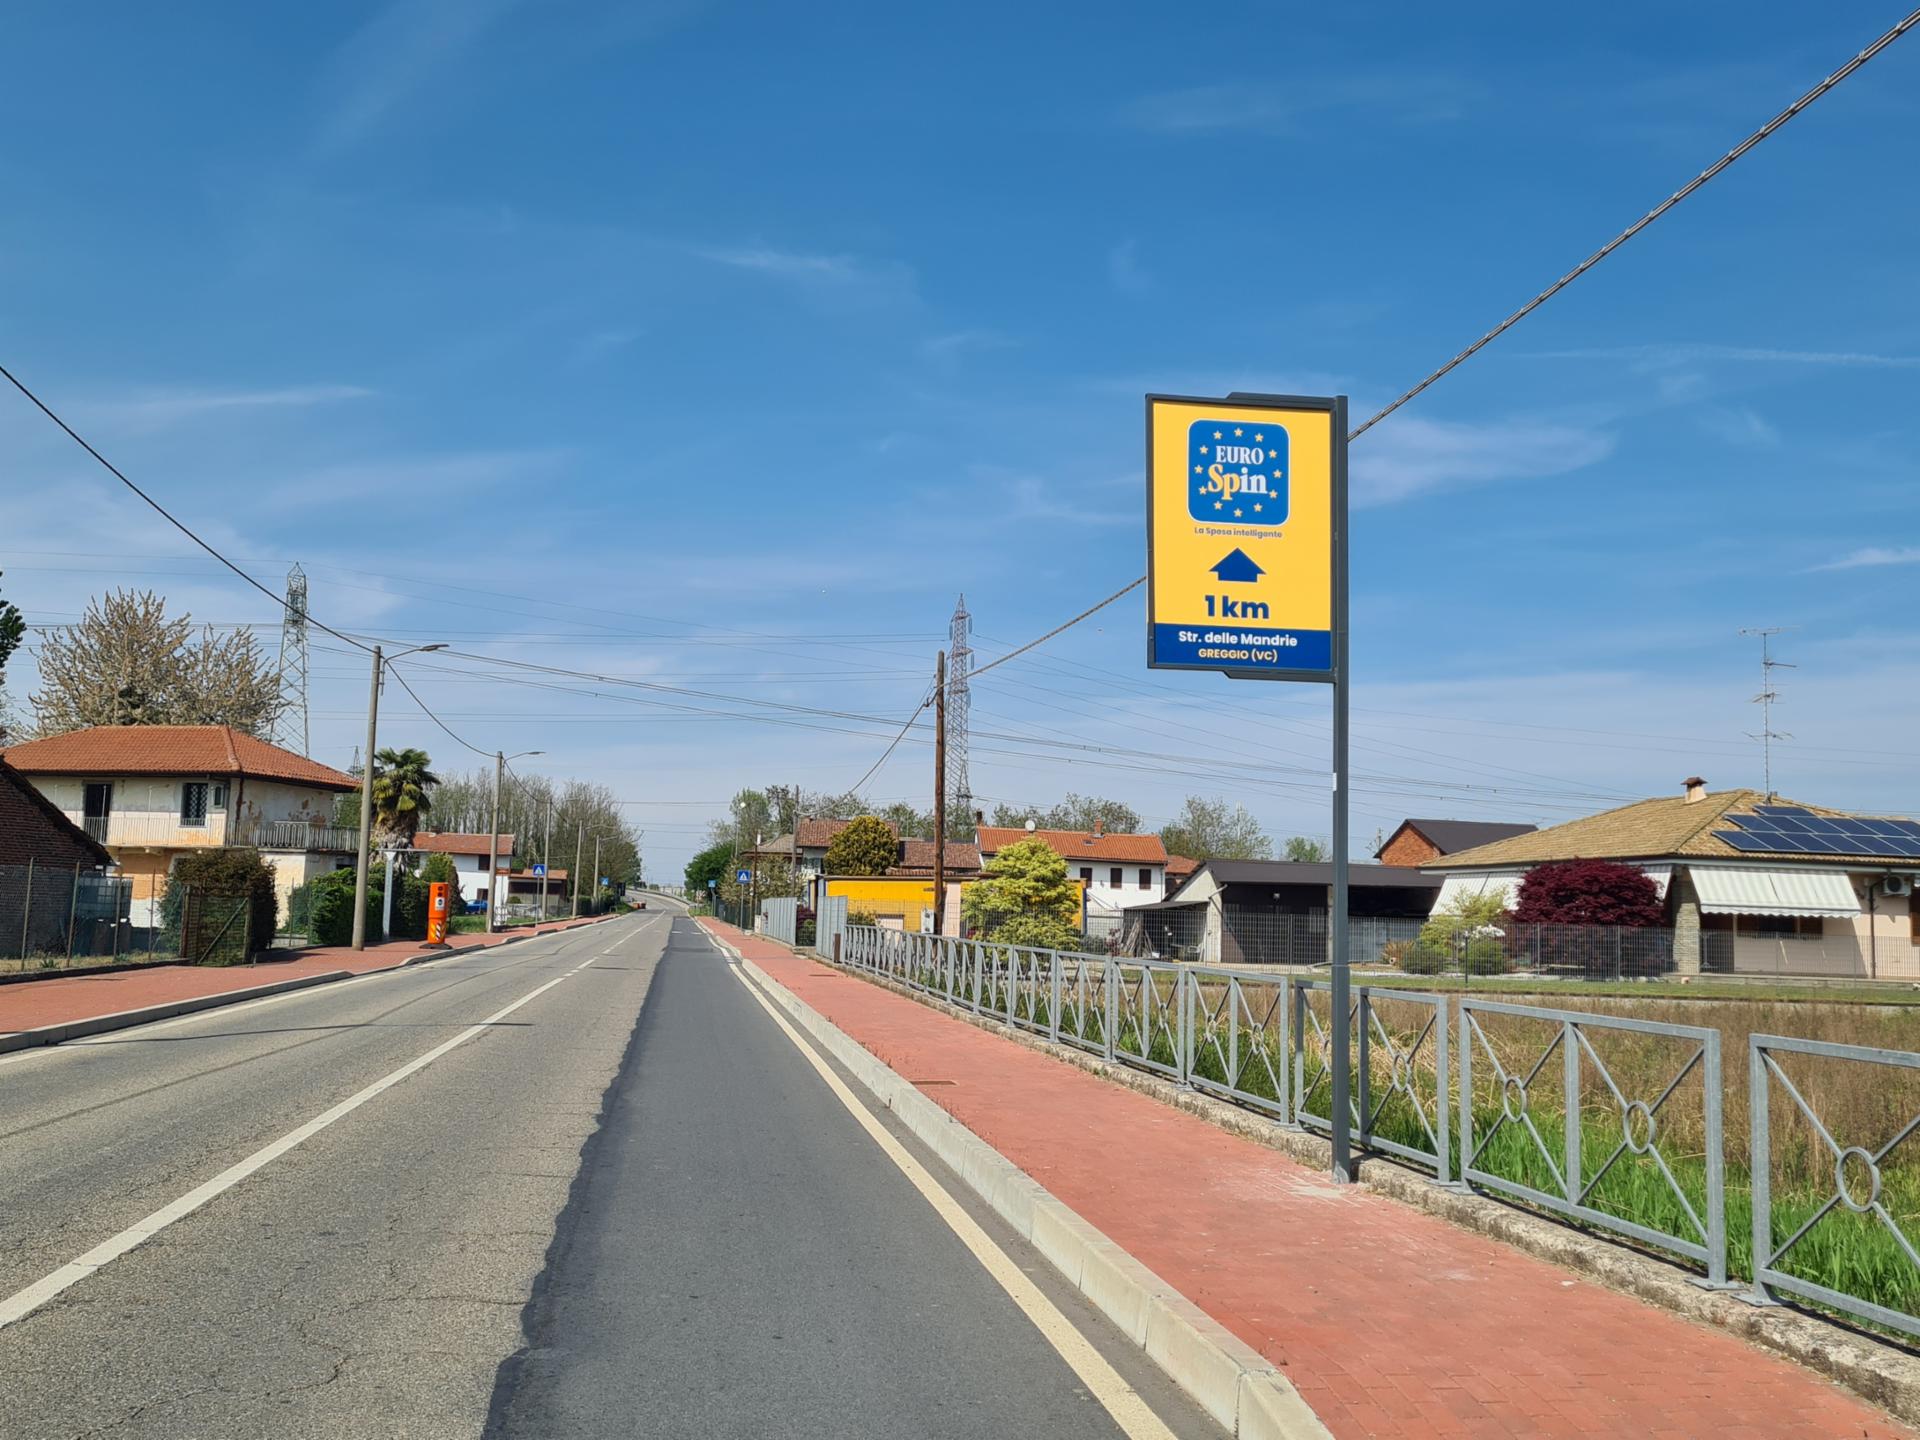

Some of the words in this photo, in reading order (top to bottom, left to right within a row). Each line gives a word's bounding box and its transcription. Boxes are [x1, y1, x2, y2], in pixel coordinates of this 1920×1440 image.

[1215, 445, 1264, 465] EURO
[1207, 464, 1269, 500] Spin
[1222, 595, 1270, 619] km
[1178, 630, 1202, 643] Str.
[1204, 632, 1238, 644] delle
[1241, 633, 1298, 647] Mandrie
[1198, 648, 1249, 660] GREGGIO
[1251, 648, 1278, 663] (VC)
